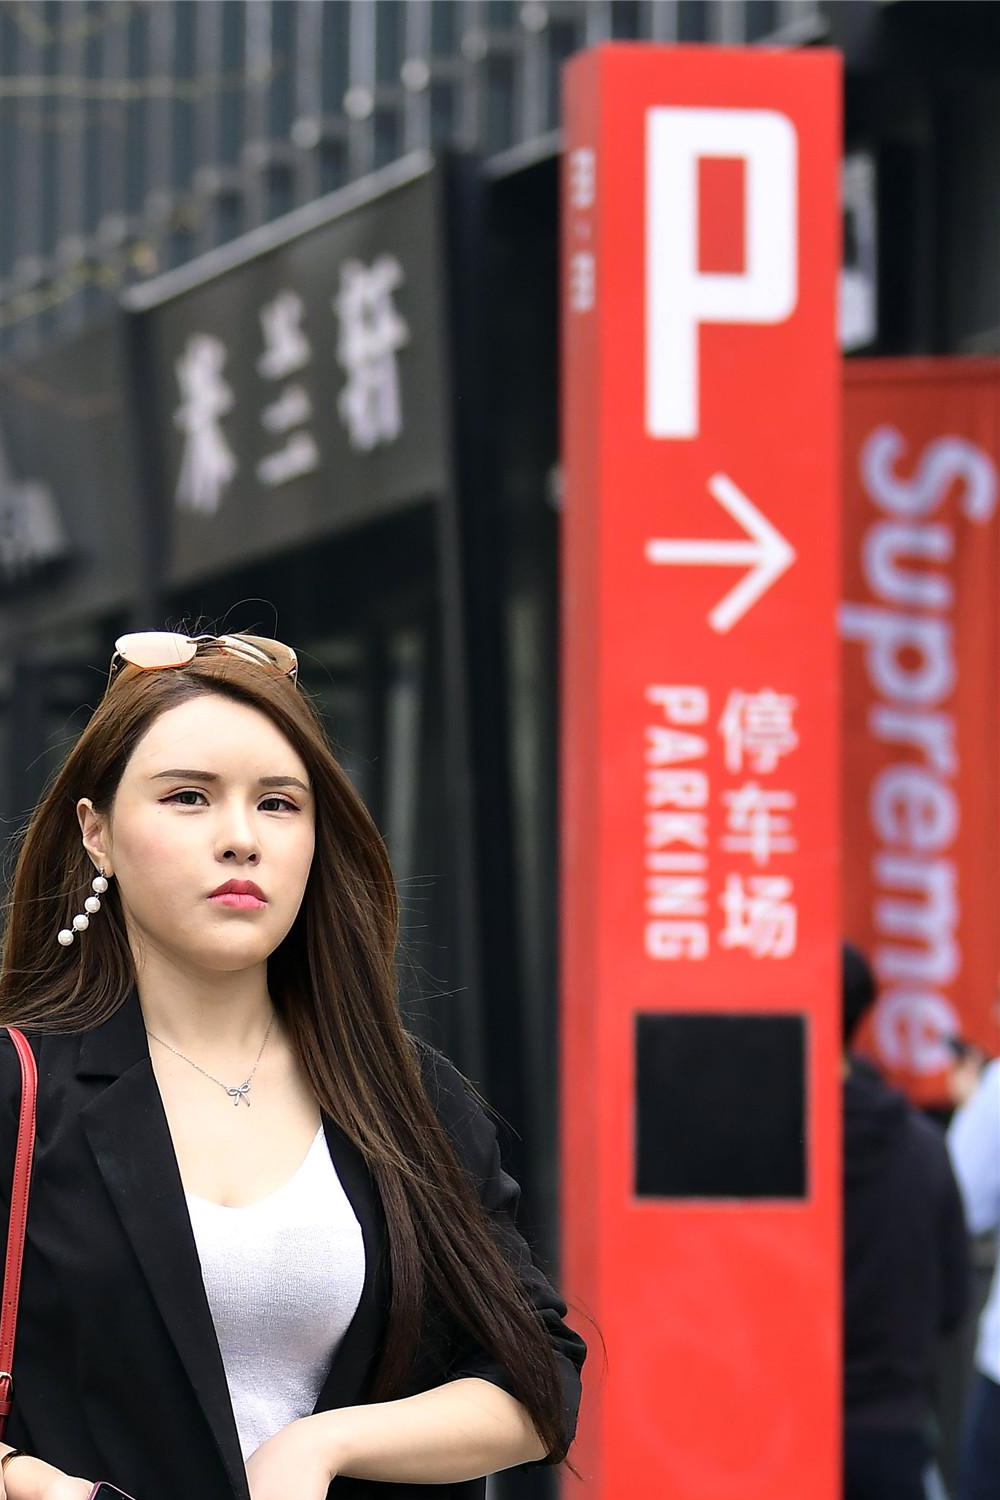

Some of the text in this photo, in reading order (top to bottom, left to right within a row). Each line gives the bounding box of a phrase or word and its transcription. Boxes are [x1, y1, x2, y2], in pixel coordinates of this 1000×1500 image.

[645, 105, 798, 440] P
[644, 683, 710, 961] PARKING
[717, 686, 799, 961] 停车场
[838, 423, 998, 1076] Supreme
